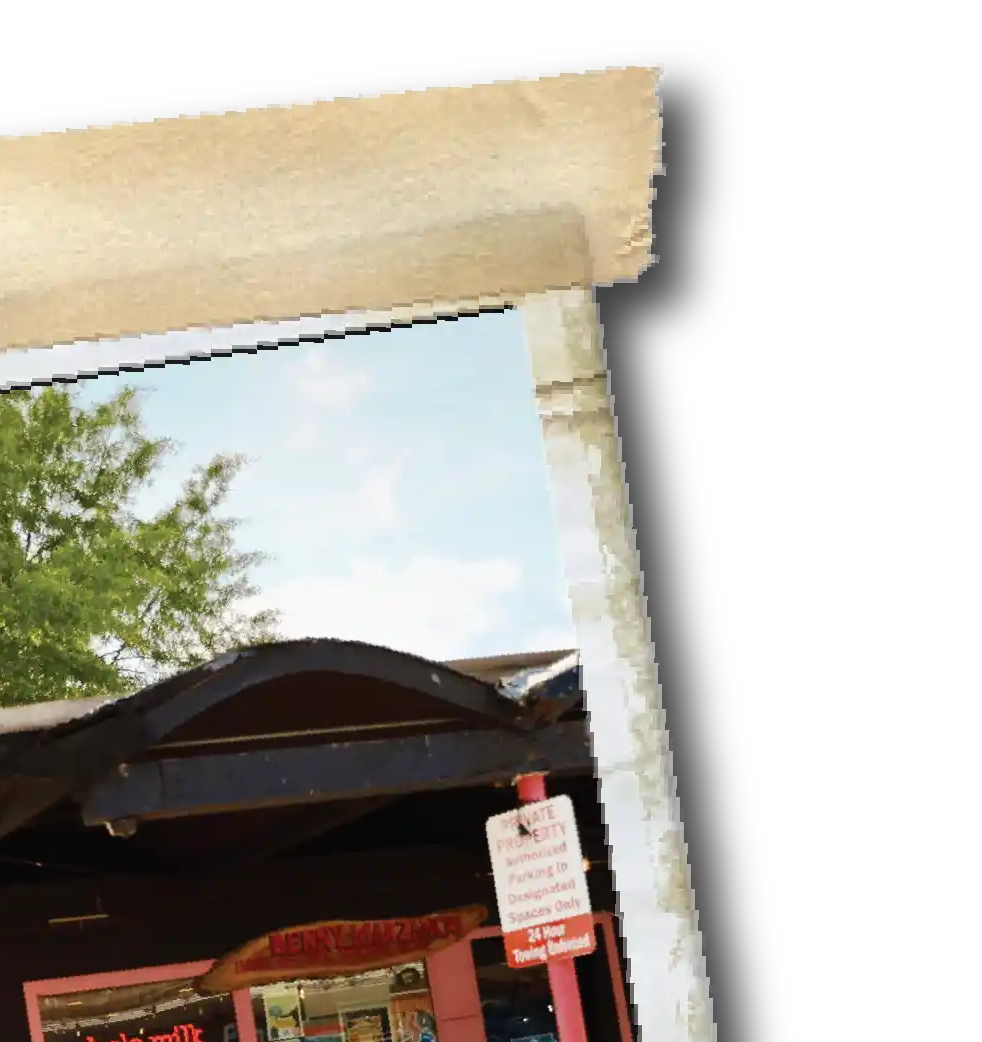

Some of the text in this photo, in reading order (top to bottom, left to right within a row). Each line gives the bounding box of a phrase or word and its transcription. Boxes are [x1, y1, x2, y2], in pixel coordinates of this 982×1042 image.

[508, 864, 555, 887] Parking
[508, 906, 552, 925] Spaces
[527, 923, 566, 943] 24 Hour
[512, 943, 548, 964] Towing
